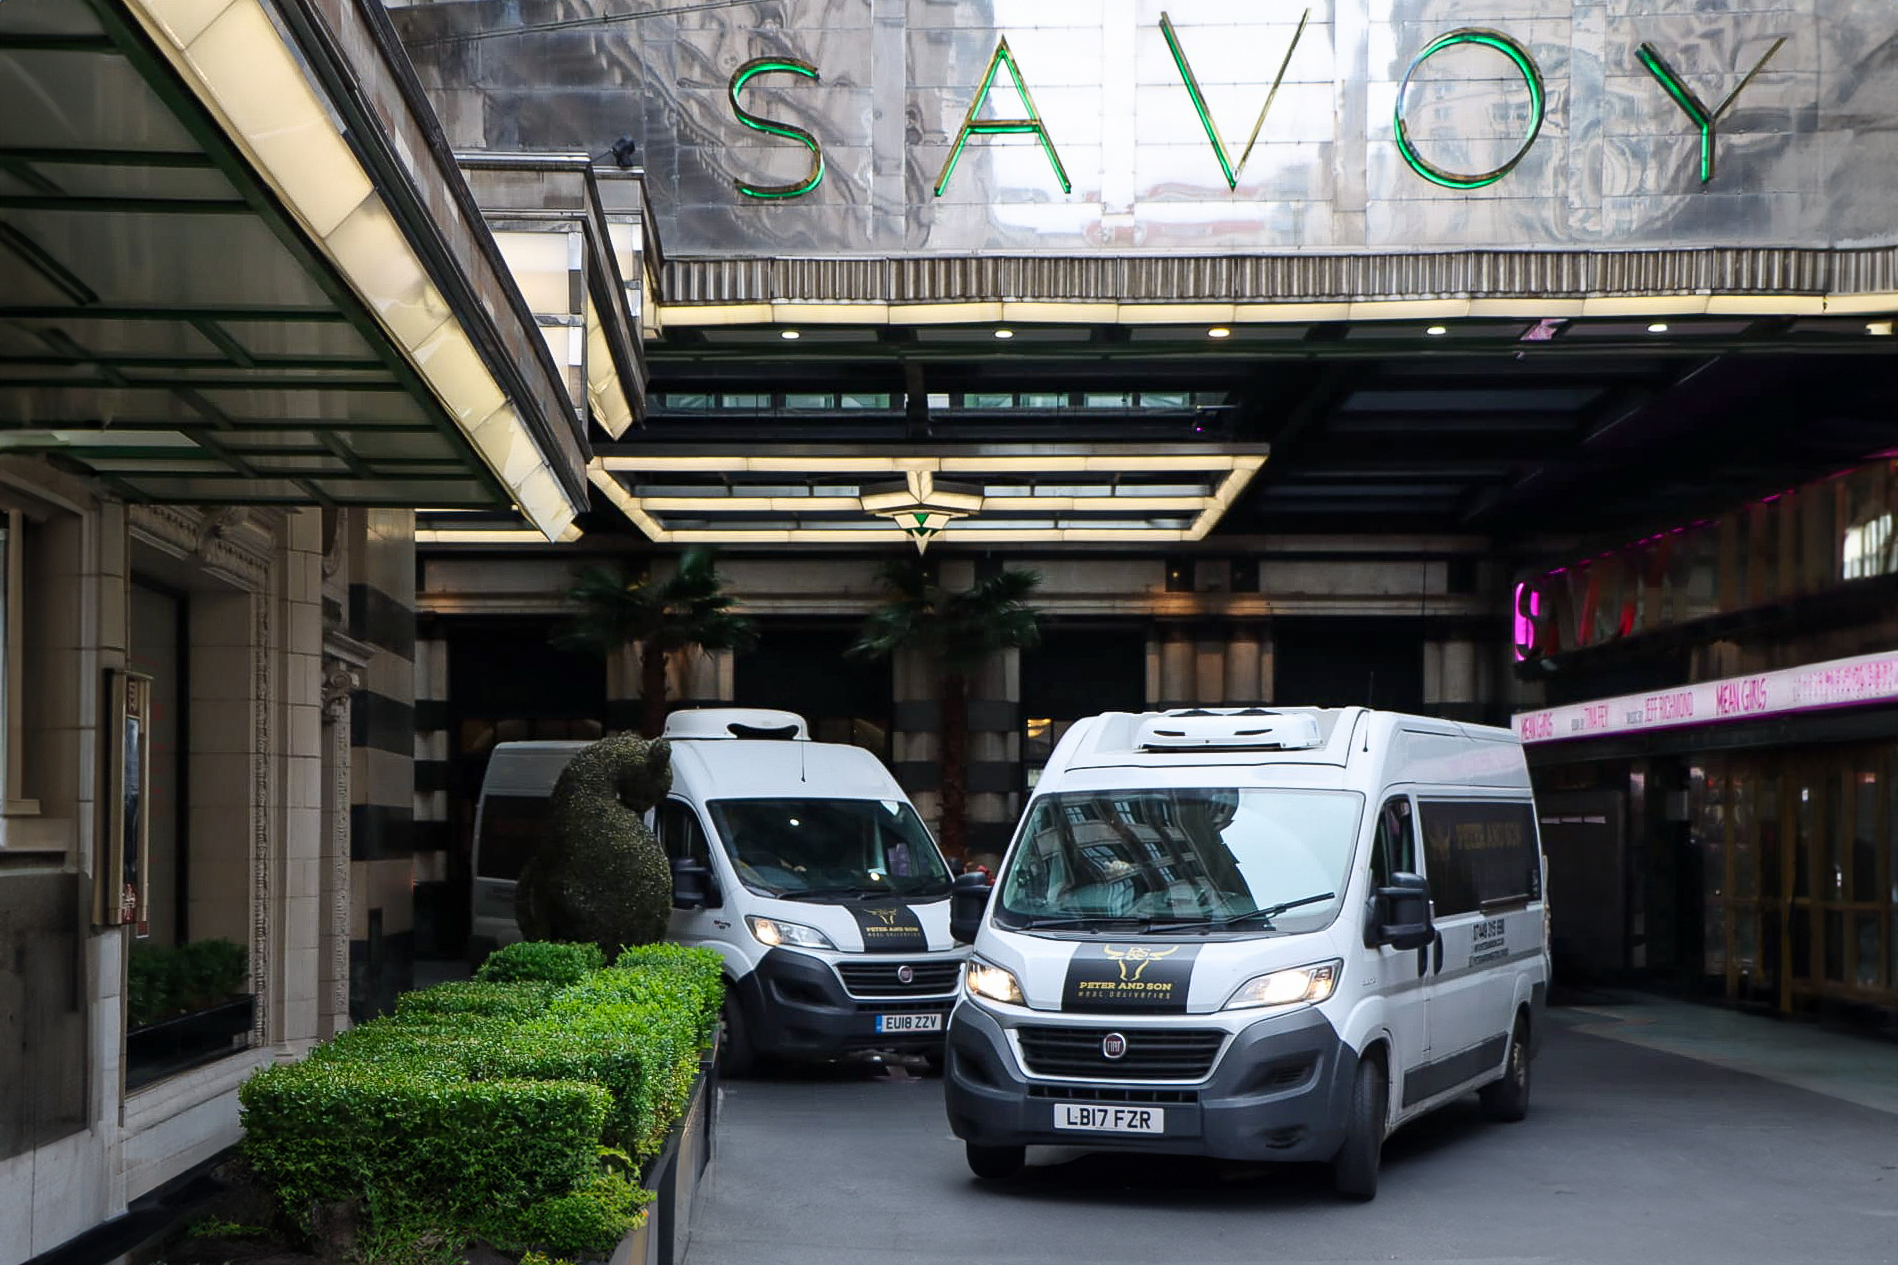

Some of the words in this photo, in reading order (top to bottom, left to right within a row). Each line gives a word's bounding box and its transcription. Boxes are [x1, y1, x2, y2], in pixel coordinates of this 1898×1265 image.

[728, 8, 1787, 198] SAVOY
[1716, 681, 1740, 716] MEAN
[1741, 677, 1767, 711] GIRLS
[1079, 981, 1115, 989] PETER
[1117, 981, 1145, 990] AND
[1146, 982, 1172, 991] SON
[886, 1016, 912, 1030] EU18
[914, 1015, 937, 1029] ZZV
[1066, 1106, 1108, 1127] LB17
[1113, 1109, 1151, 1130] FZR
